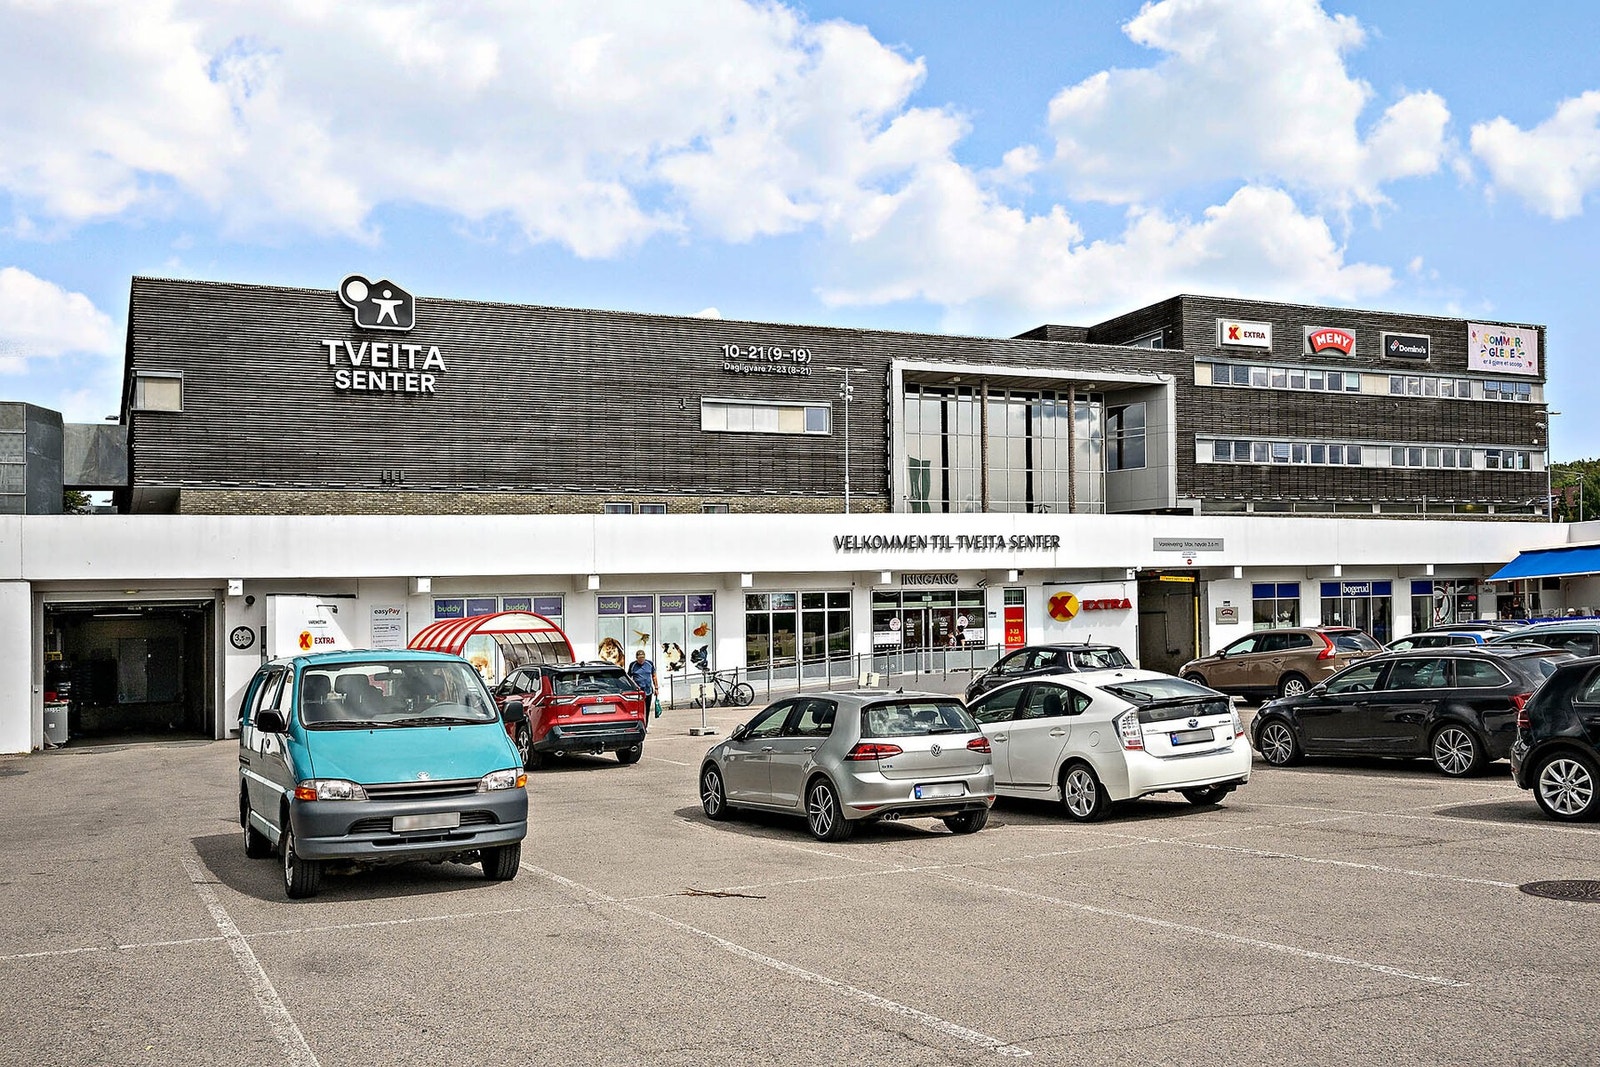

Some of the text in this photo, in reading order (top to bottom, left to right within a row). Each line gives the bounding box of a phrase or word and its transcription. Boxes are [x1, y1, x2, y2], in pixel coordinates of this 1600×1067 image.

[1243, 330, 1266, 340] EXTRA
[1316, 333, 1350, 348] MENY
[1399, 344, 1427, 354] Domino's
[1489, 347, 1516, 358] GLEDE
[322, 340, 446, 371] TVEITA
[724, 362, 766, 373] Dagligvare
[335, 370, 436, 392] SENTER
[833, 534, 1060, 550] VELKOMMEN TIL TVEITA SENTER
[901, 573, 958, 586] INNGANG
[1343, 583, 1370, 596] bogerud
[437, 605, 461, 613] buddy
[505, 603, 528, 612] buddy
[600, 602, 622, 610] buddy
[660, 600, 683, 609] buddy
[1083, 598, 1132, 611] EXTRA
[373, 607, 401, 616] easyPay
[314, 637, 335, 645] EXTRA
